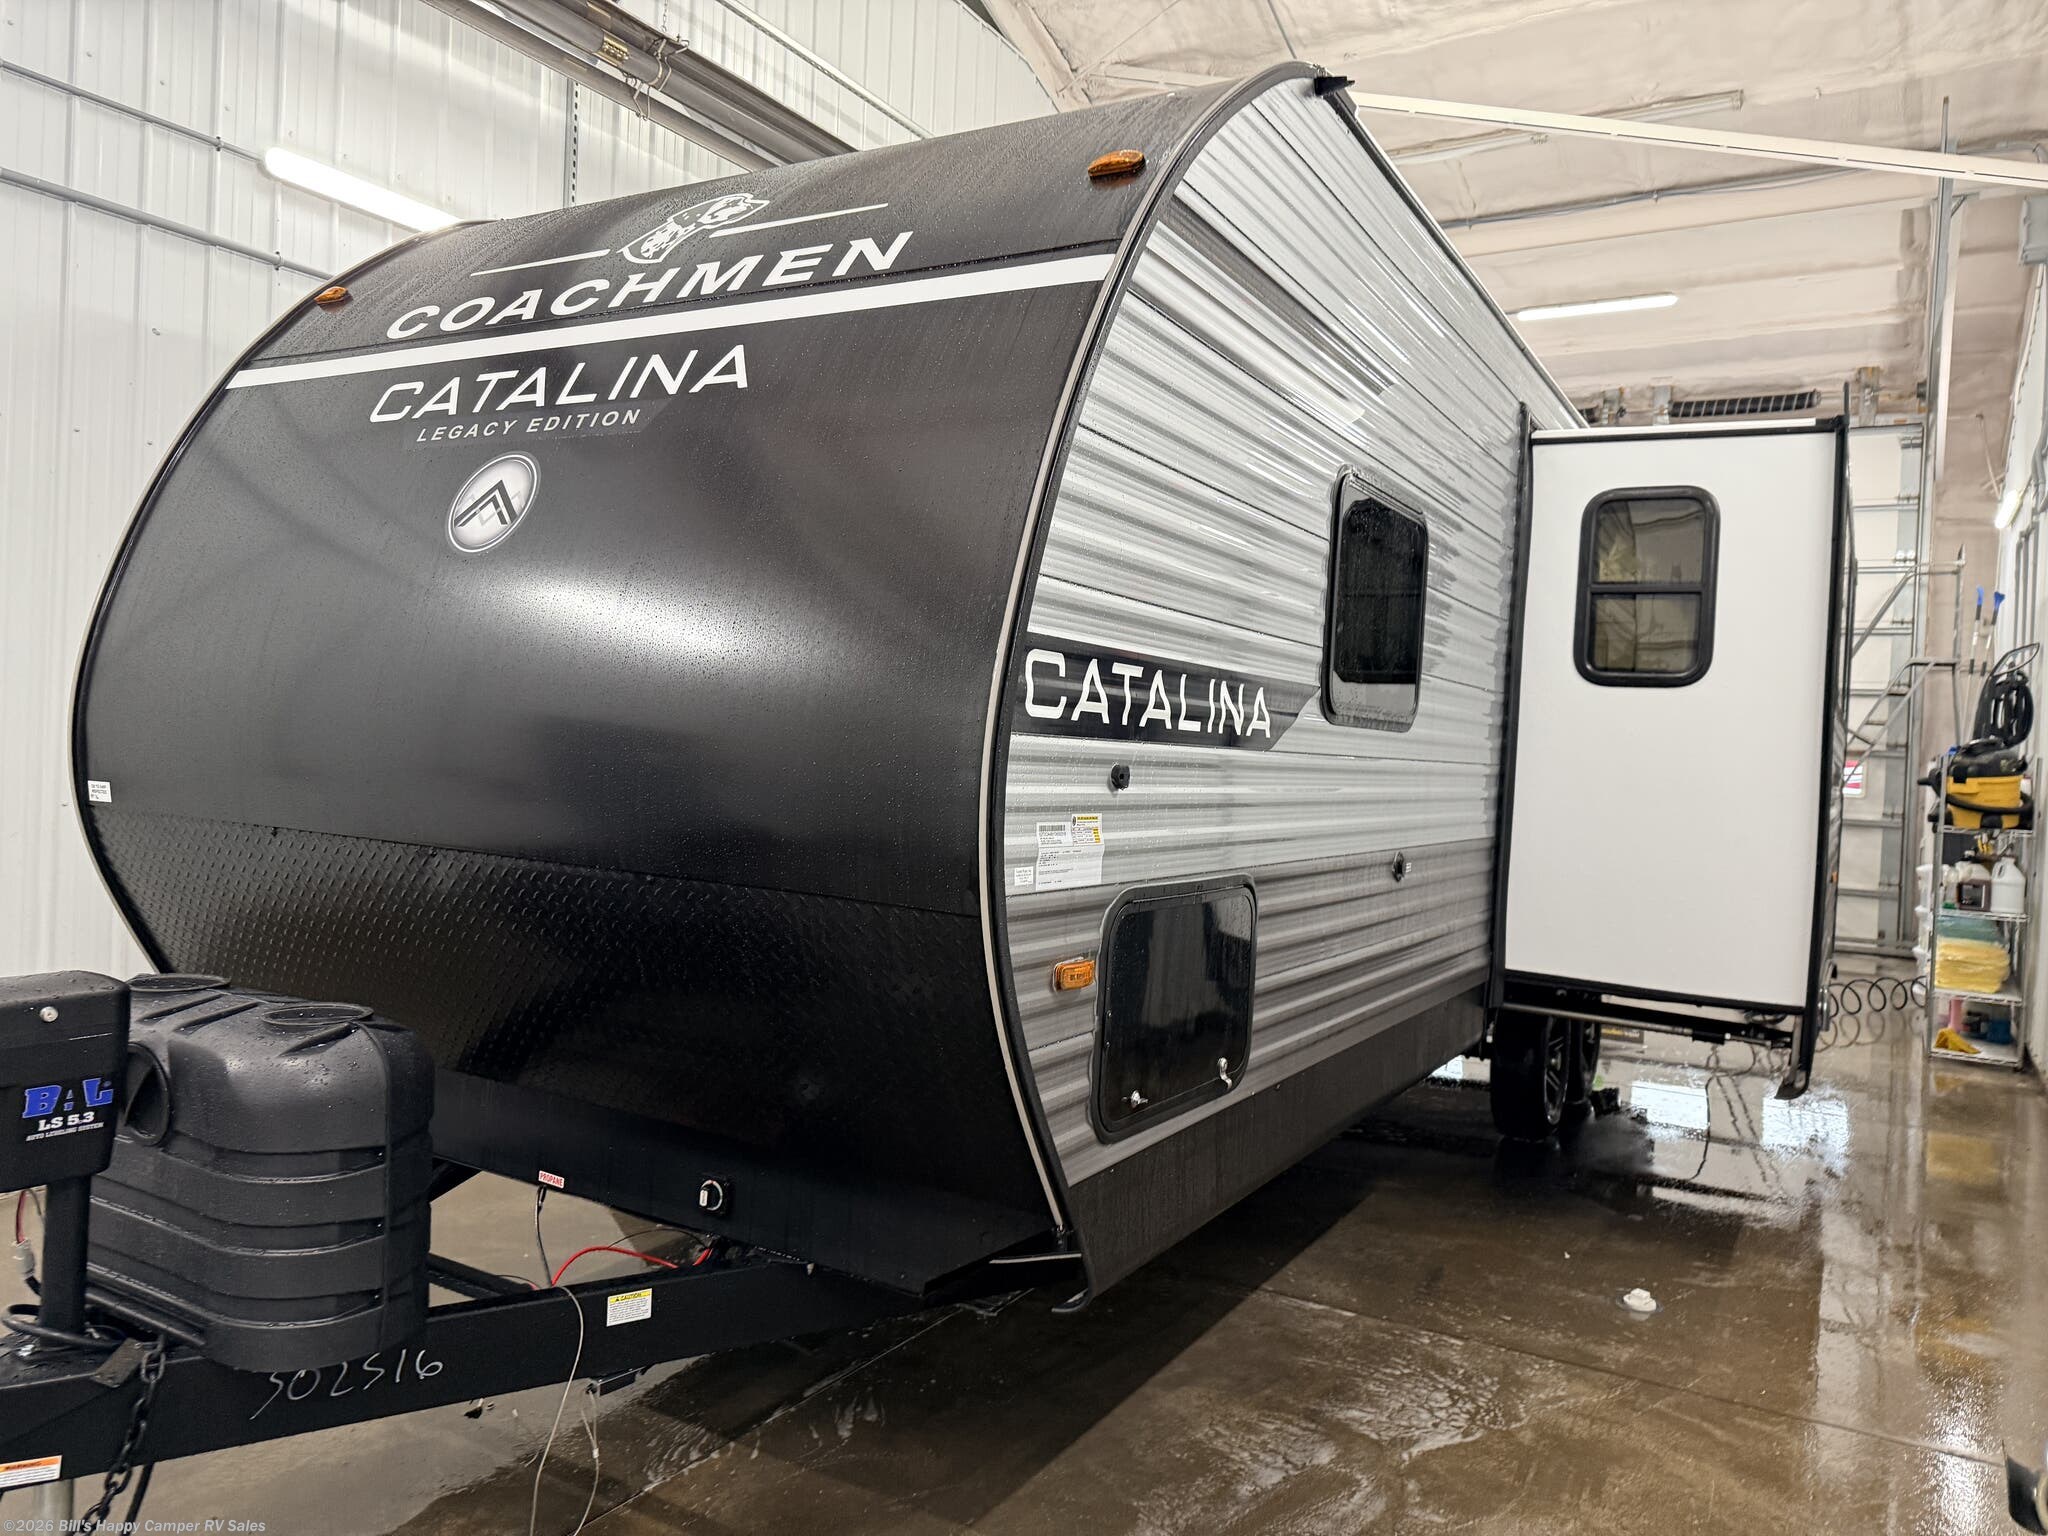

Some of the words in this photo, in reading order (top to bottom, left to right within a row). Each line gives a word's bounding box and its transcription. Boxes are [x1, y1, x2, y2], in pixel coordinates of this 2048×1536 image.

[386, 231, 913, 340] COACHMEN
[369, 345, 749, 423] CATALINA
[416, 419, 518, 443] LEGACY
[526, 408, 642, 434] EDITION
[1025, 648, 1271, 738] CATALINA
[38, 1116, 64, 1132] LS
[66, 1111, 95, 1126] 5.3
